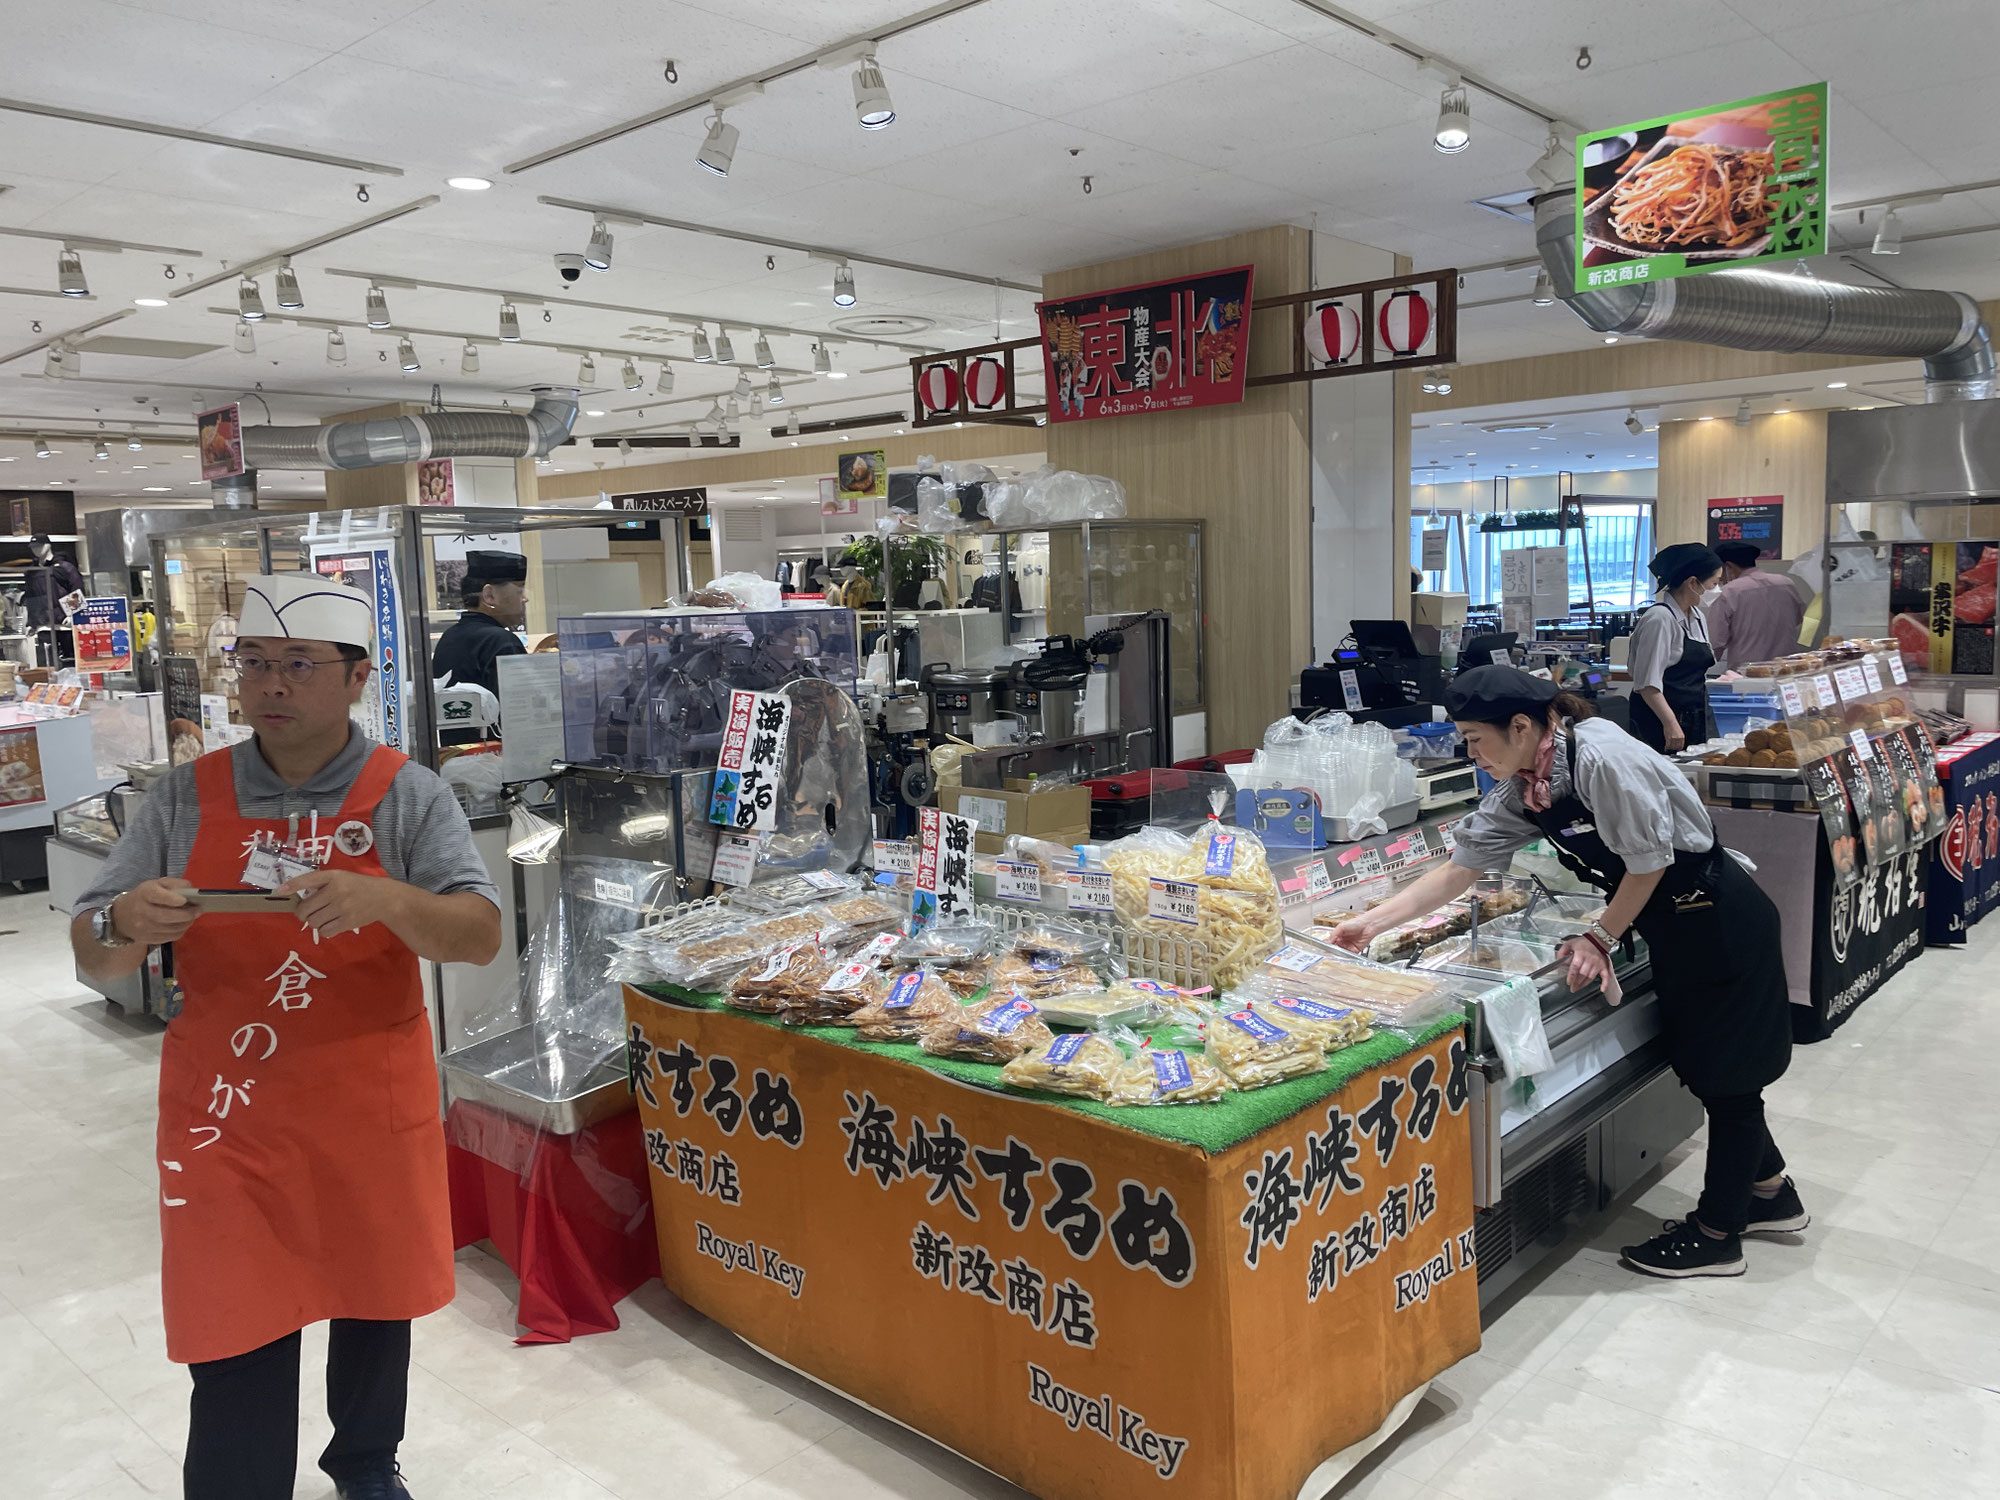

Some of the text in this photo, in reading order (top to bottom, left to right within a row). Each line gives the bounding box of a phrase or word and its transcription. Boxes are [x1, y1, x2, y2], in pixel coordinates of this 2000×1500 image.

[1766, 94, 1820, 252] 青森
[1776, 170, 1810, 183] Aomori
[1587, 264, 1649, 286] 新改商店
[1134, 306, 1150, 389] 物産大会
[635, 495, 692, 511] レストスペース
[1932, 582, 1952, 637] 米沢牛
[723, 694, 752, 768] 実演販売
[736, 698, 785, 829] 海峡するめ
[919, 809, 938, 889] 実演販売
[1010, 865, 1038, 876] 海峡するめ
[1016, 882, 1037, 892] ¥2160
[1087, 892, 1110, 903] ¥2160
[1165, 883, 1197, 898] 燻製さきいか
[1170, 902, 1195, 914] ¥2160
[647, 1131, 741, 1203] 改商店
[843, 1093, 1193, 1285] 海峡するめ
[698, 1223, 804, 1295] Royal Key
[1308, 1168, 1436, 1298] 新改商店
[913, 1224, 1096, 1345] 新改商店
[1395, 1241, 1453, 1310] Royal
[1030, 1365, 1186, 1478] Royal Key
